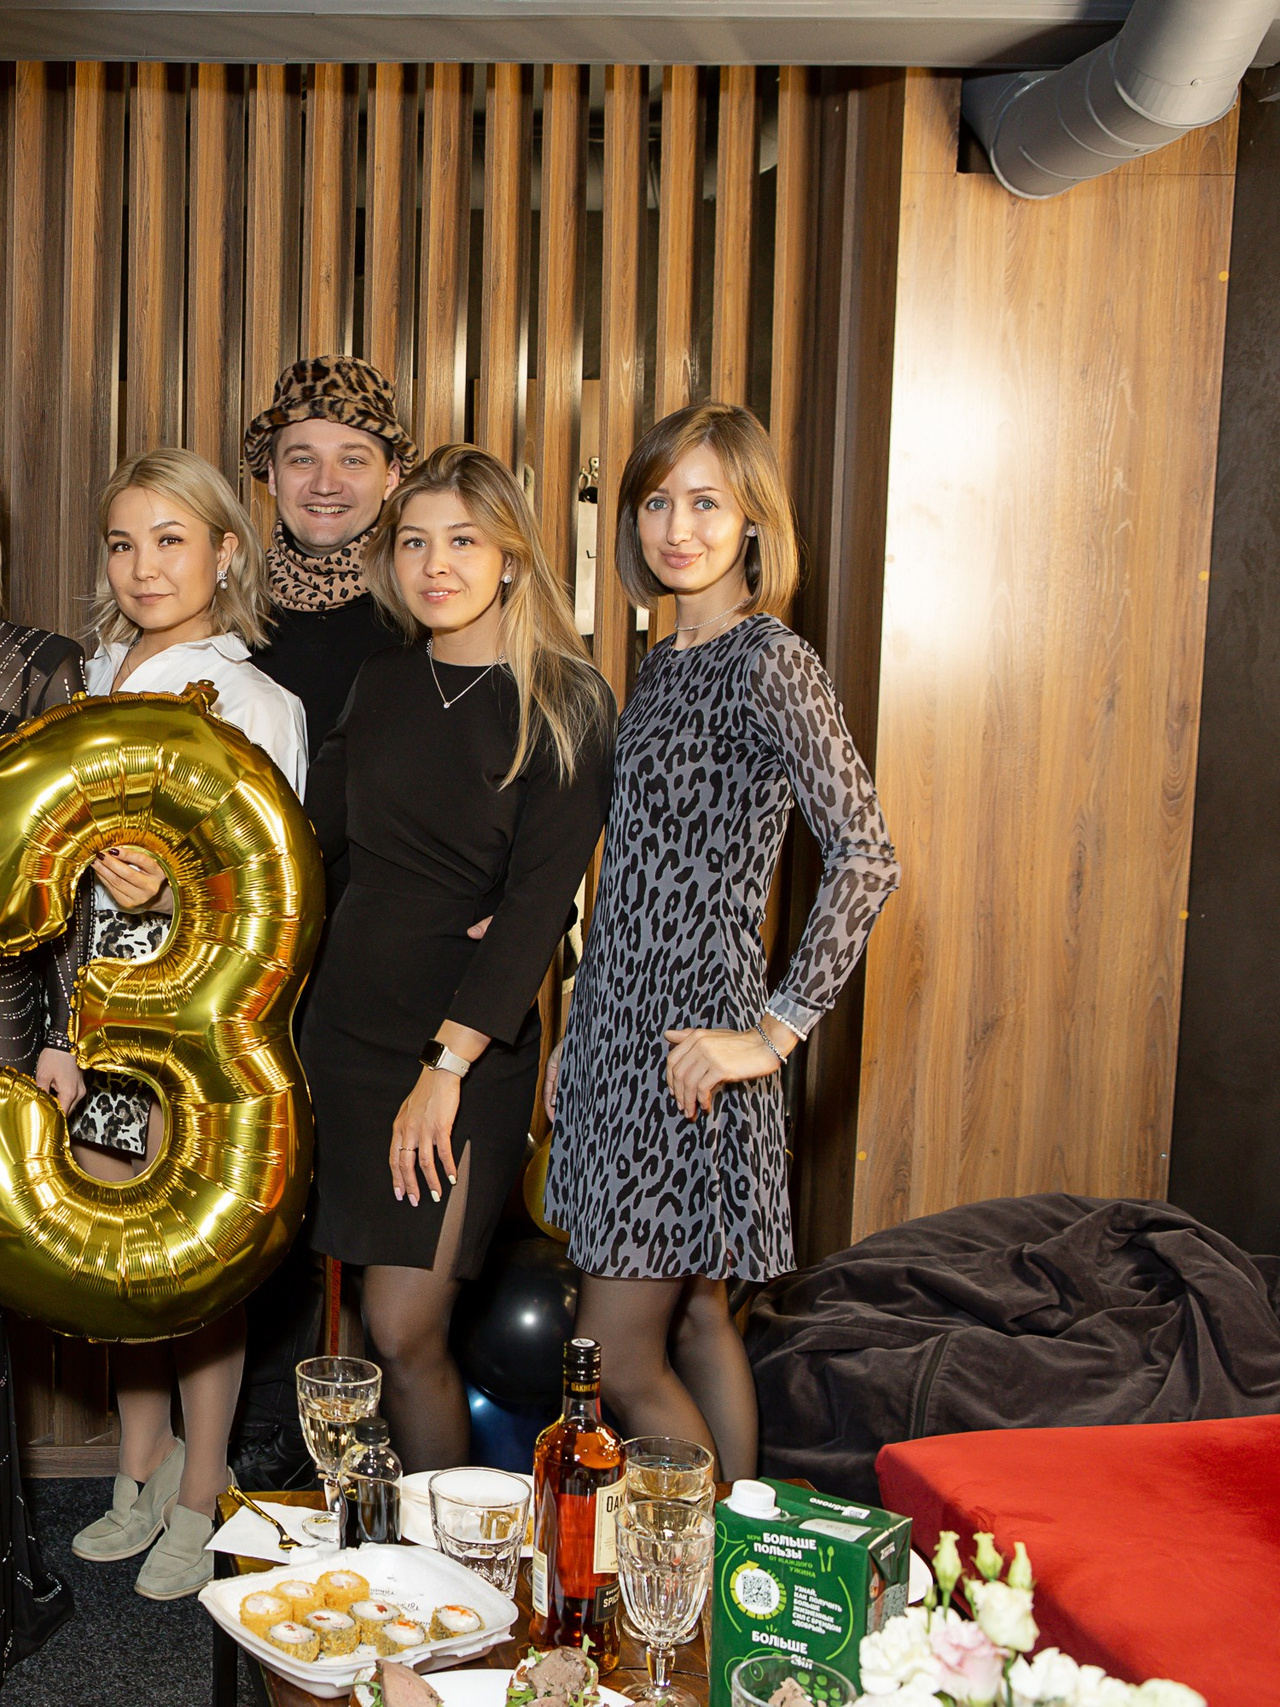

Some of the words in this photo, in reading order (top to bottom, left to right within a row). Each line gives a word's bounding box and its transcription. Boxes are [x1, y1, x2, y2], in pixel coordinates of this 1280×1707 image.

[762, 1532, 817, 1550] БОЛЬШЕ
[753, 1542, 802, 1560] ПОЛЬЗЫ
[751, 1630, 808, 1655] БОЛЬШЕ
